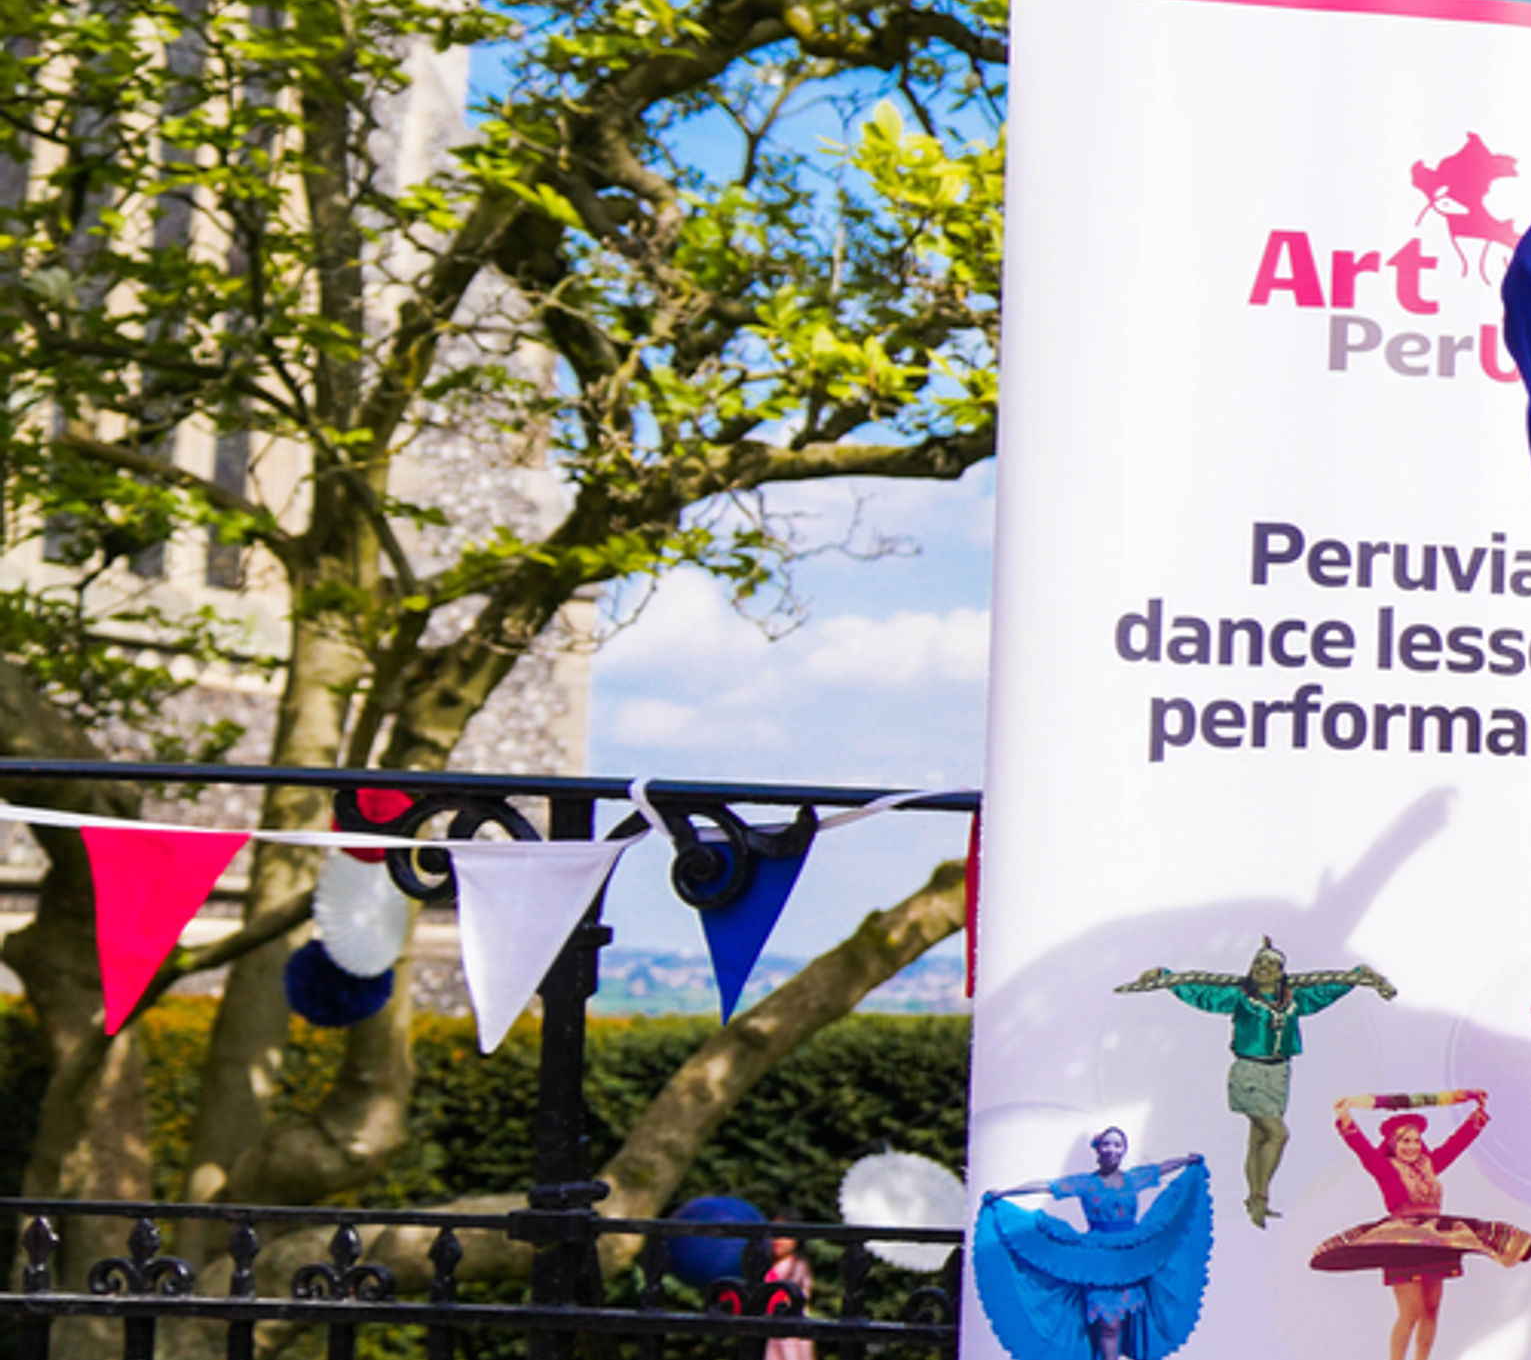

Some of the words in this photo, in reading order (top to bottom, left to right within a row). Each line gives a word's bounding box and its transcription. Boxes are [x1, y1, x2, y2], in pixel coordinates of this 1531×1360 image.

[1249, 229, 1440, 316] Art
[1328, 313, 1523, 384] PerU
[1114, 597, 1356, 669] dance
